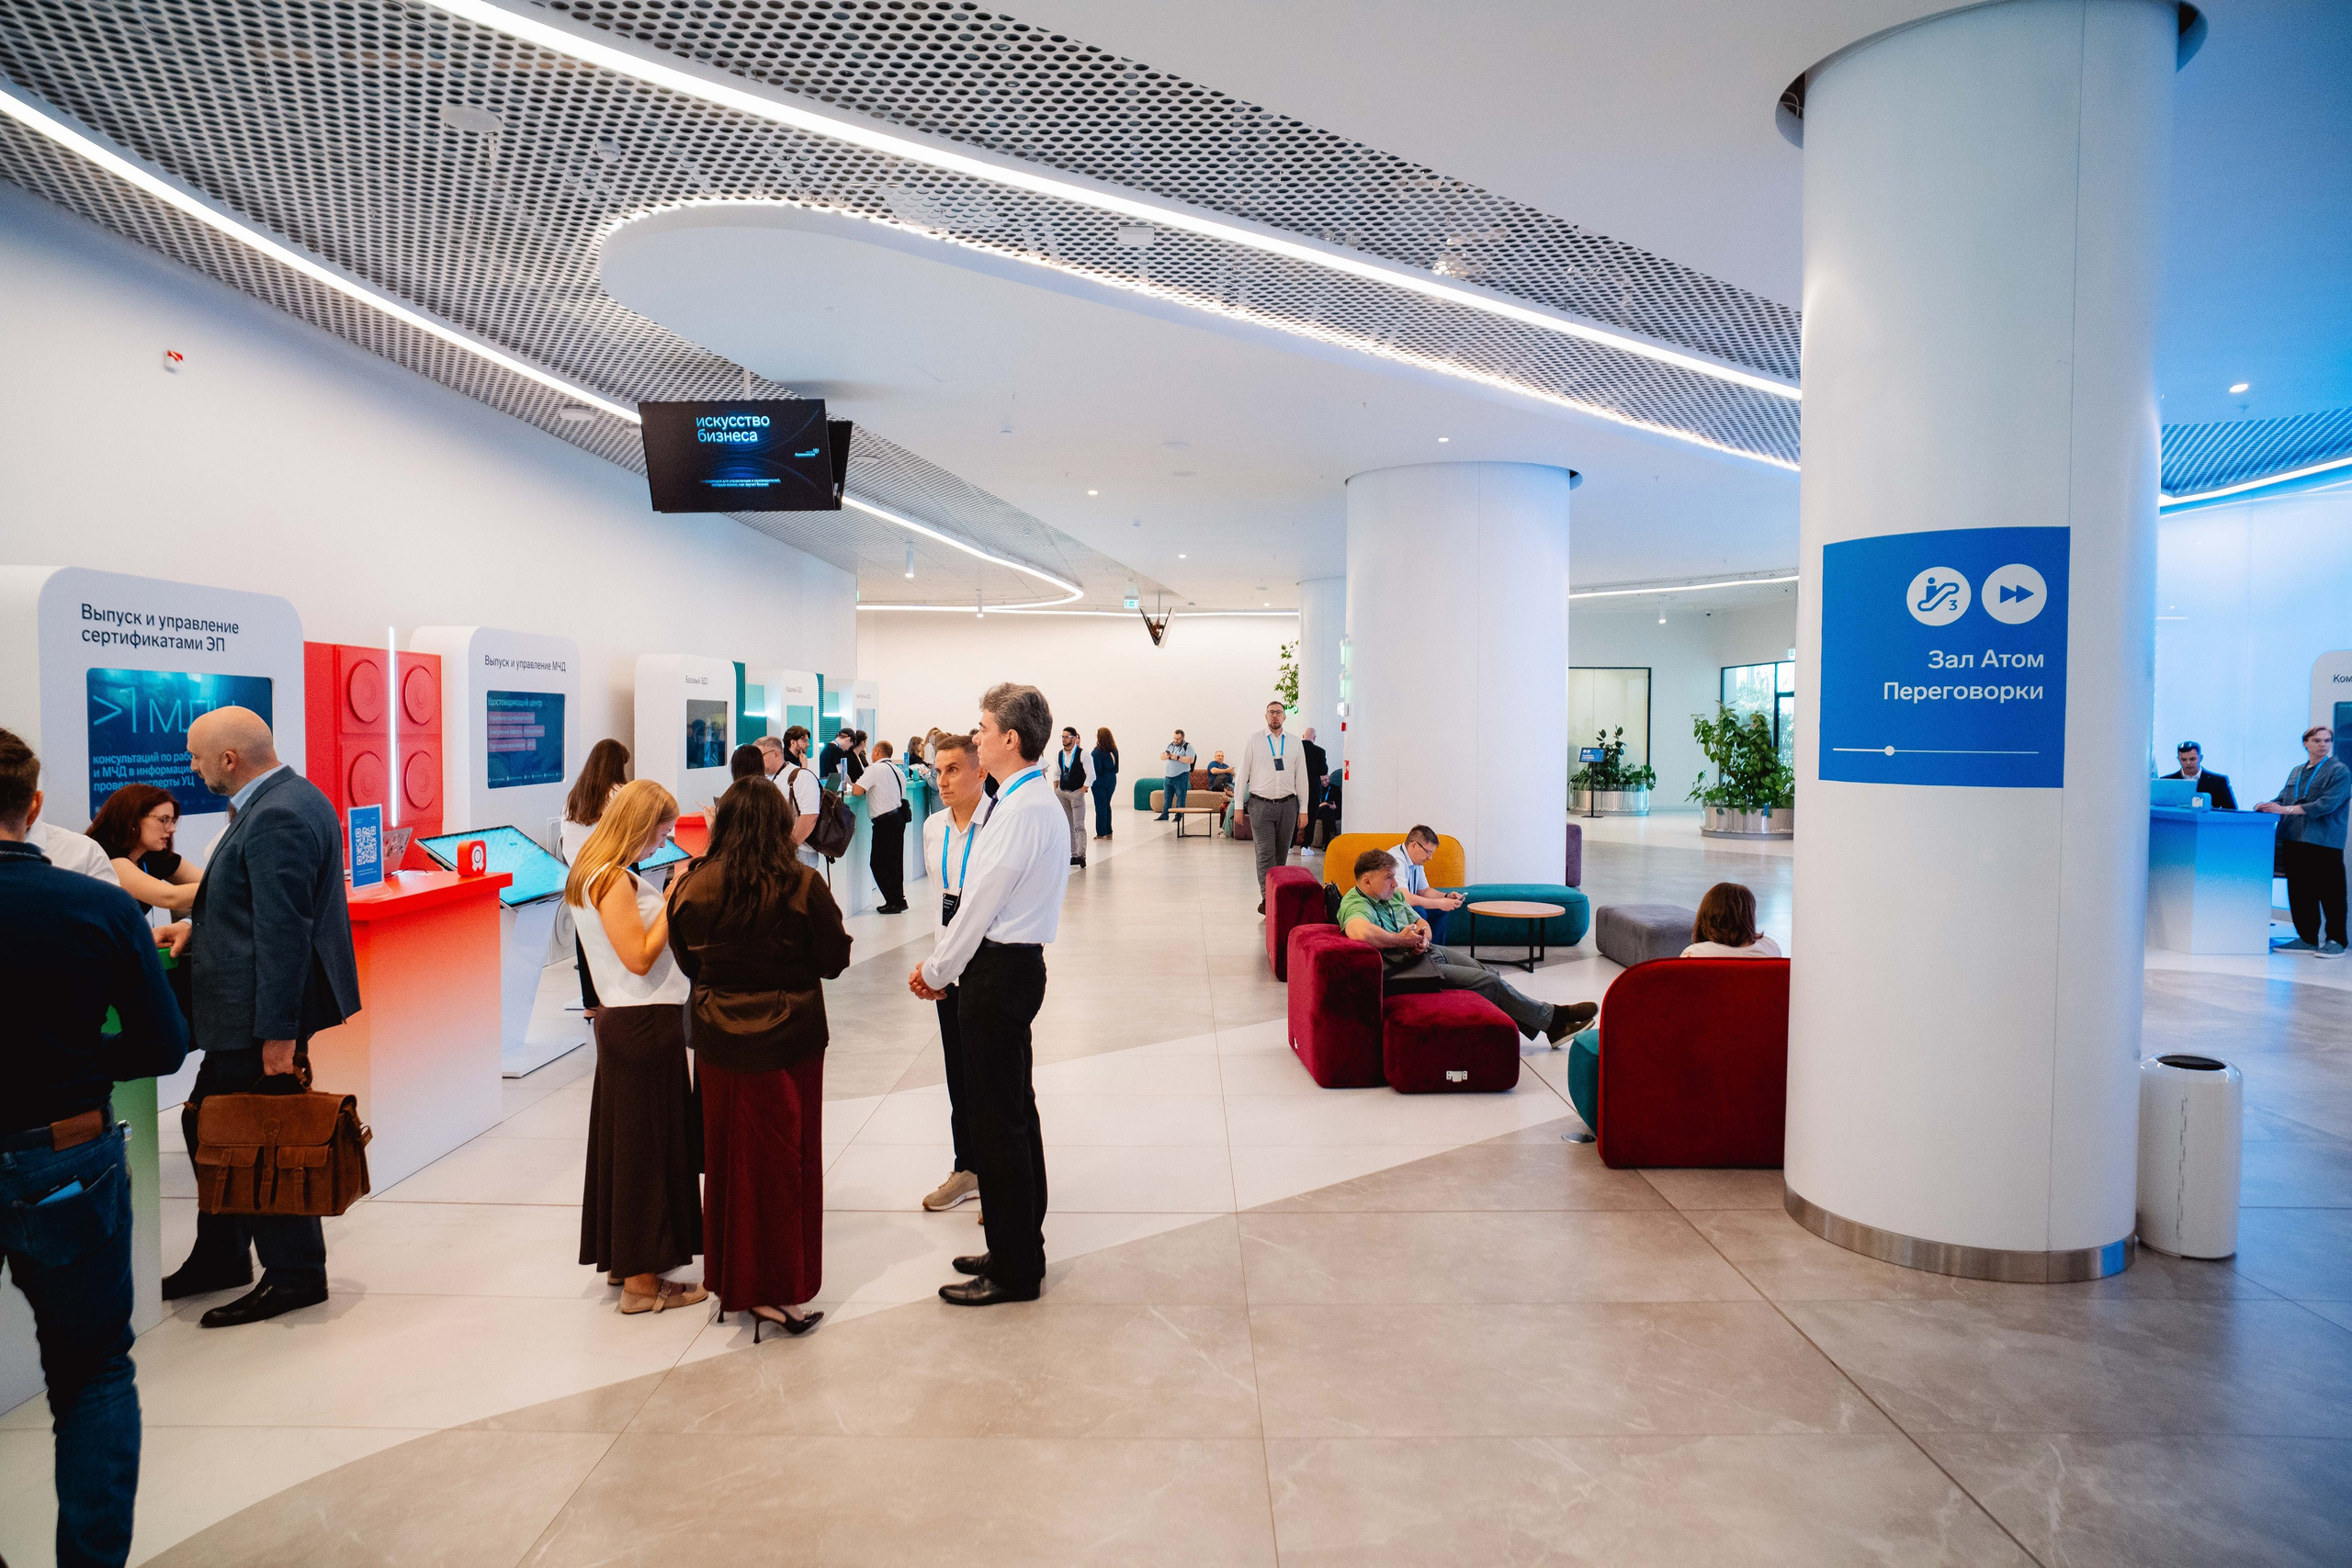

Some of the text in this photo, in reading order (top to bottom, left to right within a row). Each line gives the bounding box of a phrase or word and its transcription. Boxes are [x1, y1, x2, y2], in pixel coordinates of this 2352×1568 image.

[695, 415, 770, 429] искусство
[696, 429, 758, 443] бизнеса
[1948, 599, 1958, 611] 3
[81, 603, 240, 634] Выпуск и управление
[81, 628, 226, 652] сертификатами ЭП
[484, 655, 566, 672] Выпуск и управление МЧД
[1928, 649, 2044, 669] Зал Атом
[1883, 682, 2044, 704] Переговорки
[93, 751, 160, 766] консультаций
[161, 753, 172, 762] по
[93, 769, 100, 778] и
[102, 765, 128, 779] МЧД
[129, 768, 135, 776] в
[94, 780, 136, 794] прове
[181, 775, 195, 787] УЦ
